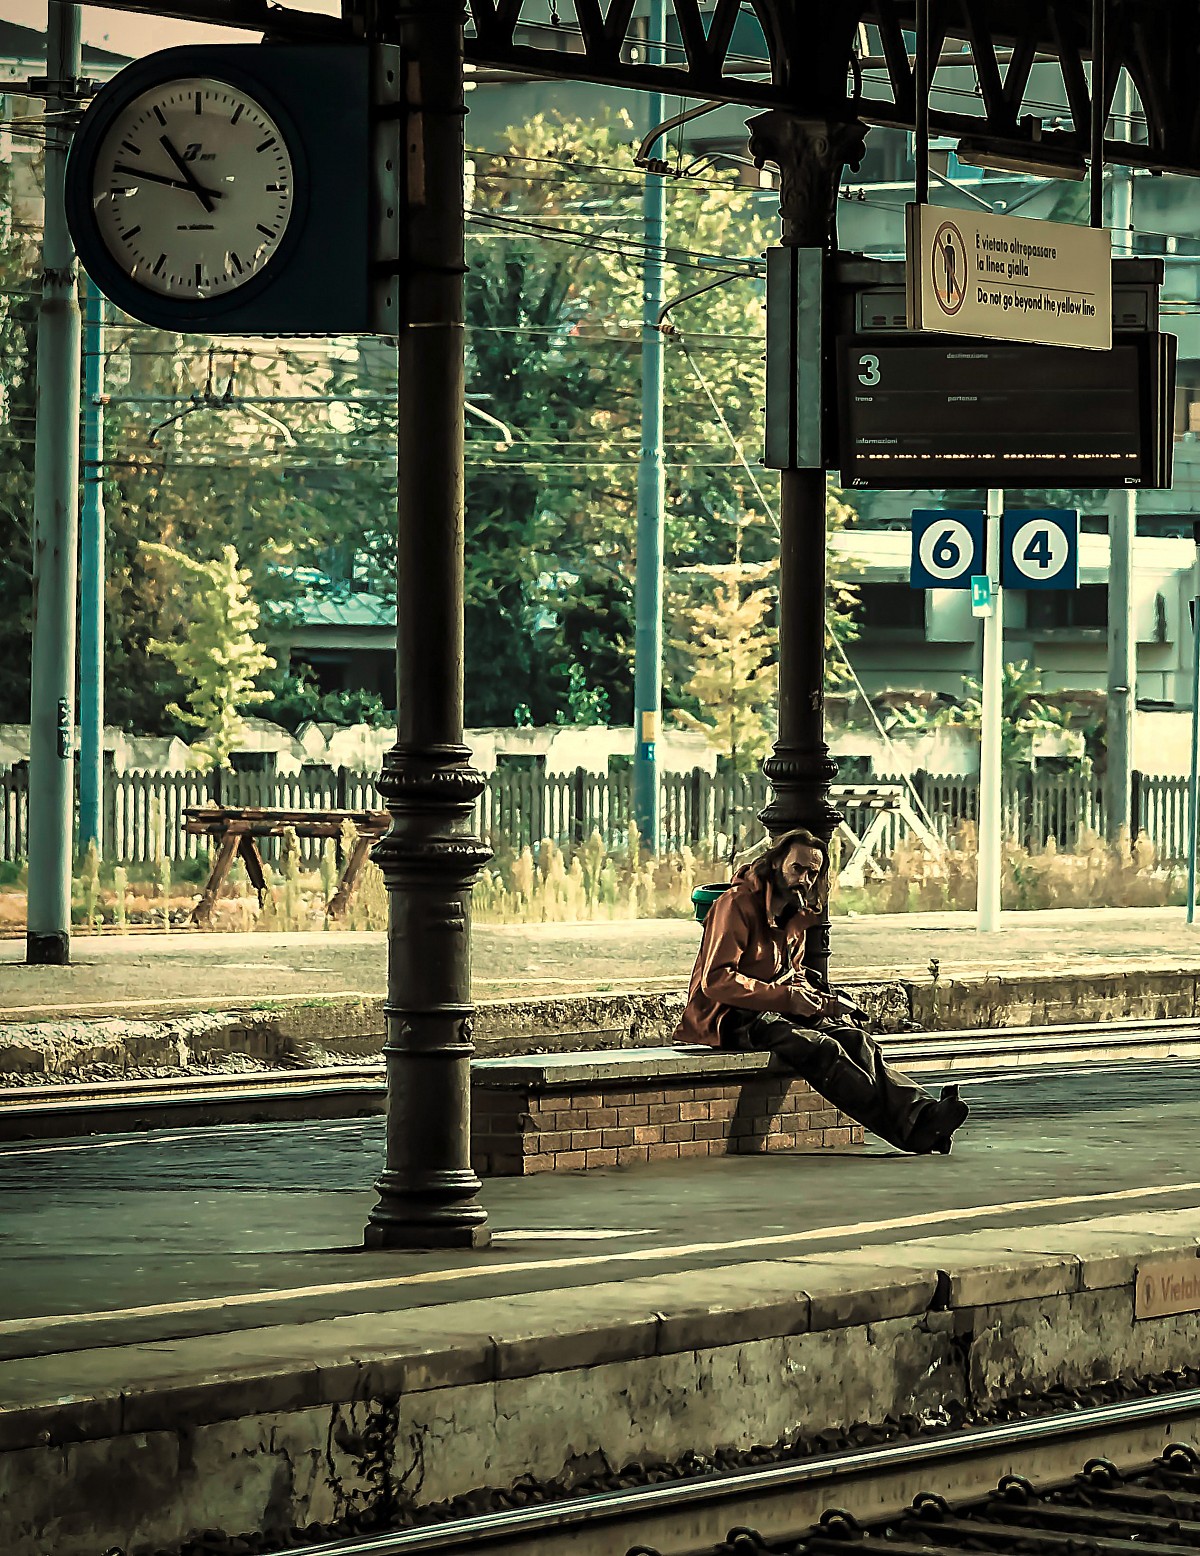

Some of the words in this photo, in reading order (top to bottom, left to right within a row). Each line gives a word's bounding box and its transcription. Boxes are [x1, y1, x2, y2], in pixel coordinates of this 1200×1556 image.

[981, 234, 1009, 254] vietato
[1009, 238, 1057, 261] oltrepassare
[976, 254, 984, 271] la
[986, 255, 1005, 274] linea
[1007, 259, 1029, 279] gialla
[977, 288, 988, 304] Do
[989, 292, 1001, 305] not
[1003, 296, 1013, 311] go
[1014, 290, 1042, 313] beyond
[1043, 295, 1056, 311] the
[1056, 296, 1082, 317] yellow
[1082, 299, 1095, 317] line
[857, 354, 881, 386] 3
[932, 530, 960, 569] 6
[1023, 530, 1053, 569] 4
